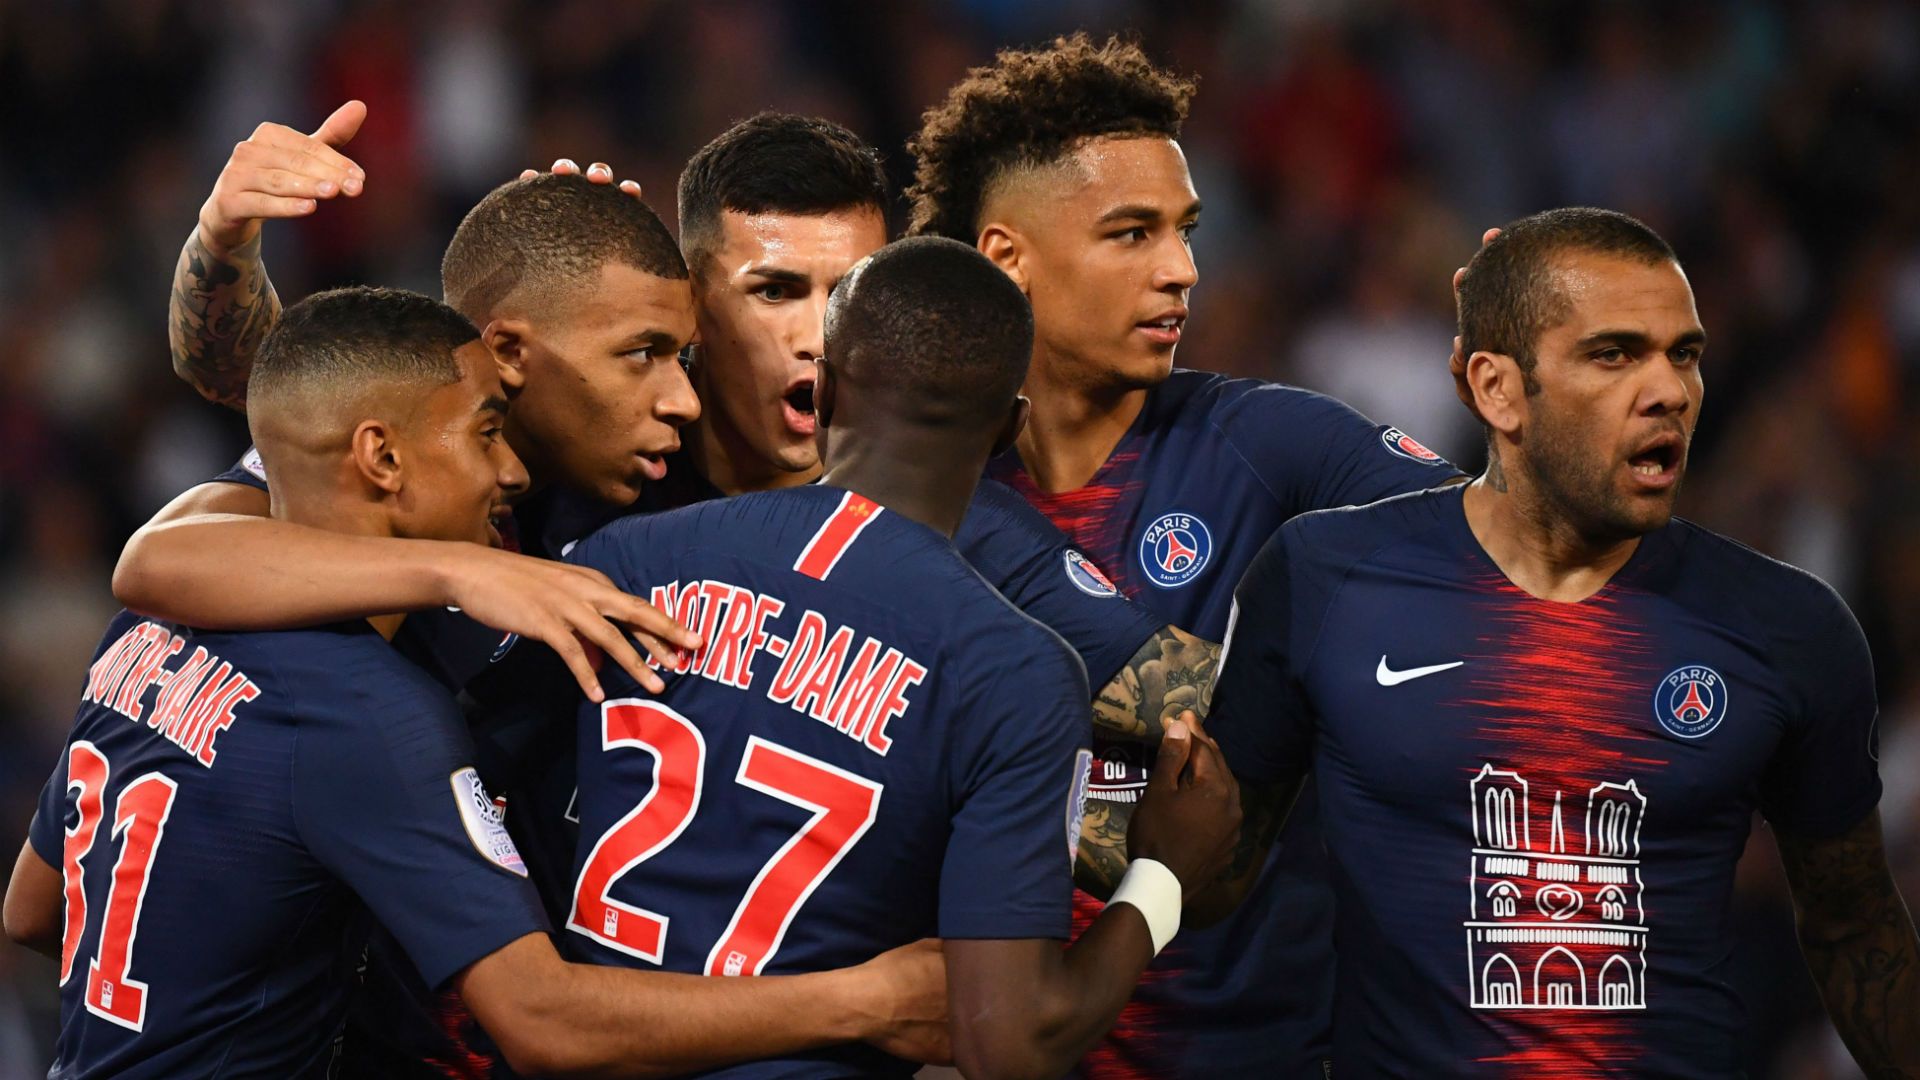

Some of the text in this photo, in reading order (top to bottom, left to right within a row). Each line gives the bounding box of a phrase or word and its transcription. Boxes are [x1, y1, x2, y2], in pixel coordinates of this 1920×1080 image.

[1146, 516, 1191, 544] PARIS
[1668, 669, 1716, 687] PARIS
[566, 697, 885, 977] 27
